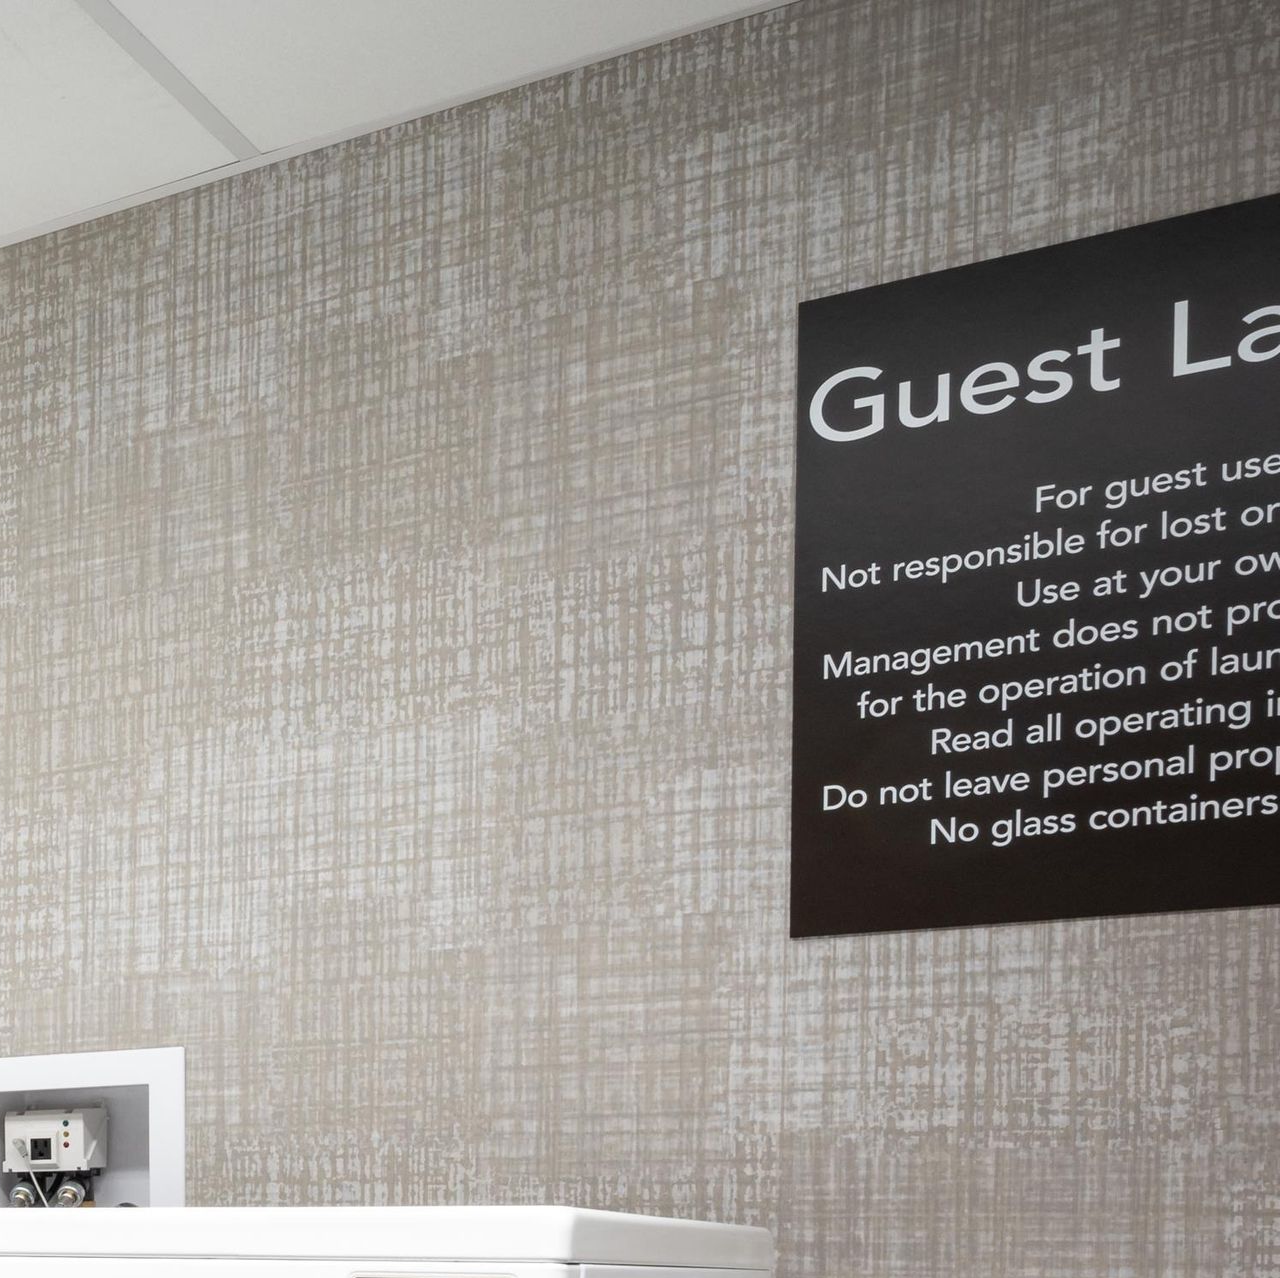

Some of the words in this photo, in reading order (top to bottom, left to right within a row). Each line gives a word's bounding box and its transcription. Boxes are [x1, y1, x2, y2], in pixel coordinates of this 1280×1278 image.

[809, 328, 1120, 442] Guest
[1036, 484, 1092, 513] For
[1105, 463, 1207, 509] guest
[1222, 454, 1280, 481] use
[822, 563, 880, 592] Not
[894, 528, 1085, 583] responsible
[1096, 519, 1147, 549] for
[1162, 508, 1226, 539] lost
[1241, 503, 1280, 526] or
[1018, 579, 1080, 607] Use
[1093, 570, 1127, 596] at
[1140, 560, 1221, 598] your
[824, 629, 1040, 679] Management
[1053, 618, 1138, 648] does
[1153, 606, 1212, 635] not
[857, 691, 903, 718] for
[913, 683, 966, 712] the
[979, 663, 1145, 711] operation
[1161, 649, 1198, 681] of
[932, 719, 1012, 755] Read
[1026, 713, 1061, 744] all
[1076, 698, 1251, 746] operating
[823, 785, 867, 810] Do
[880, 778, 932, 805] not
[946, 771, 1030, 798] leave
[1044, 745, 1194, 800] personal
[931, 817, 979, 844] No
[992, 809, 1076, 847] glass
[1089, 794, 1278, 829] containers
